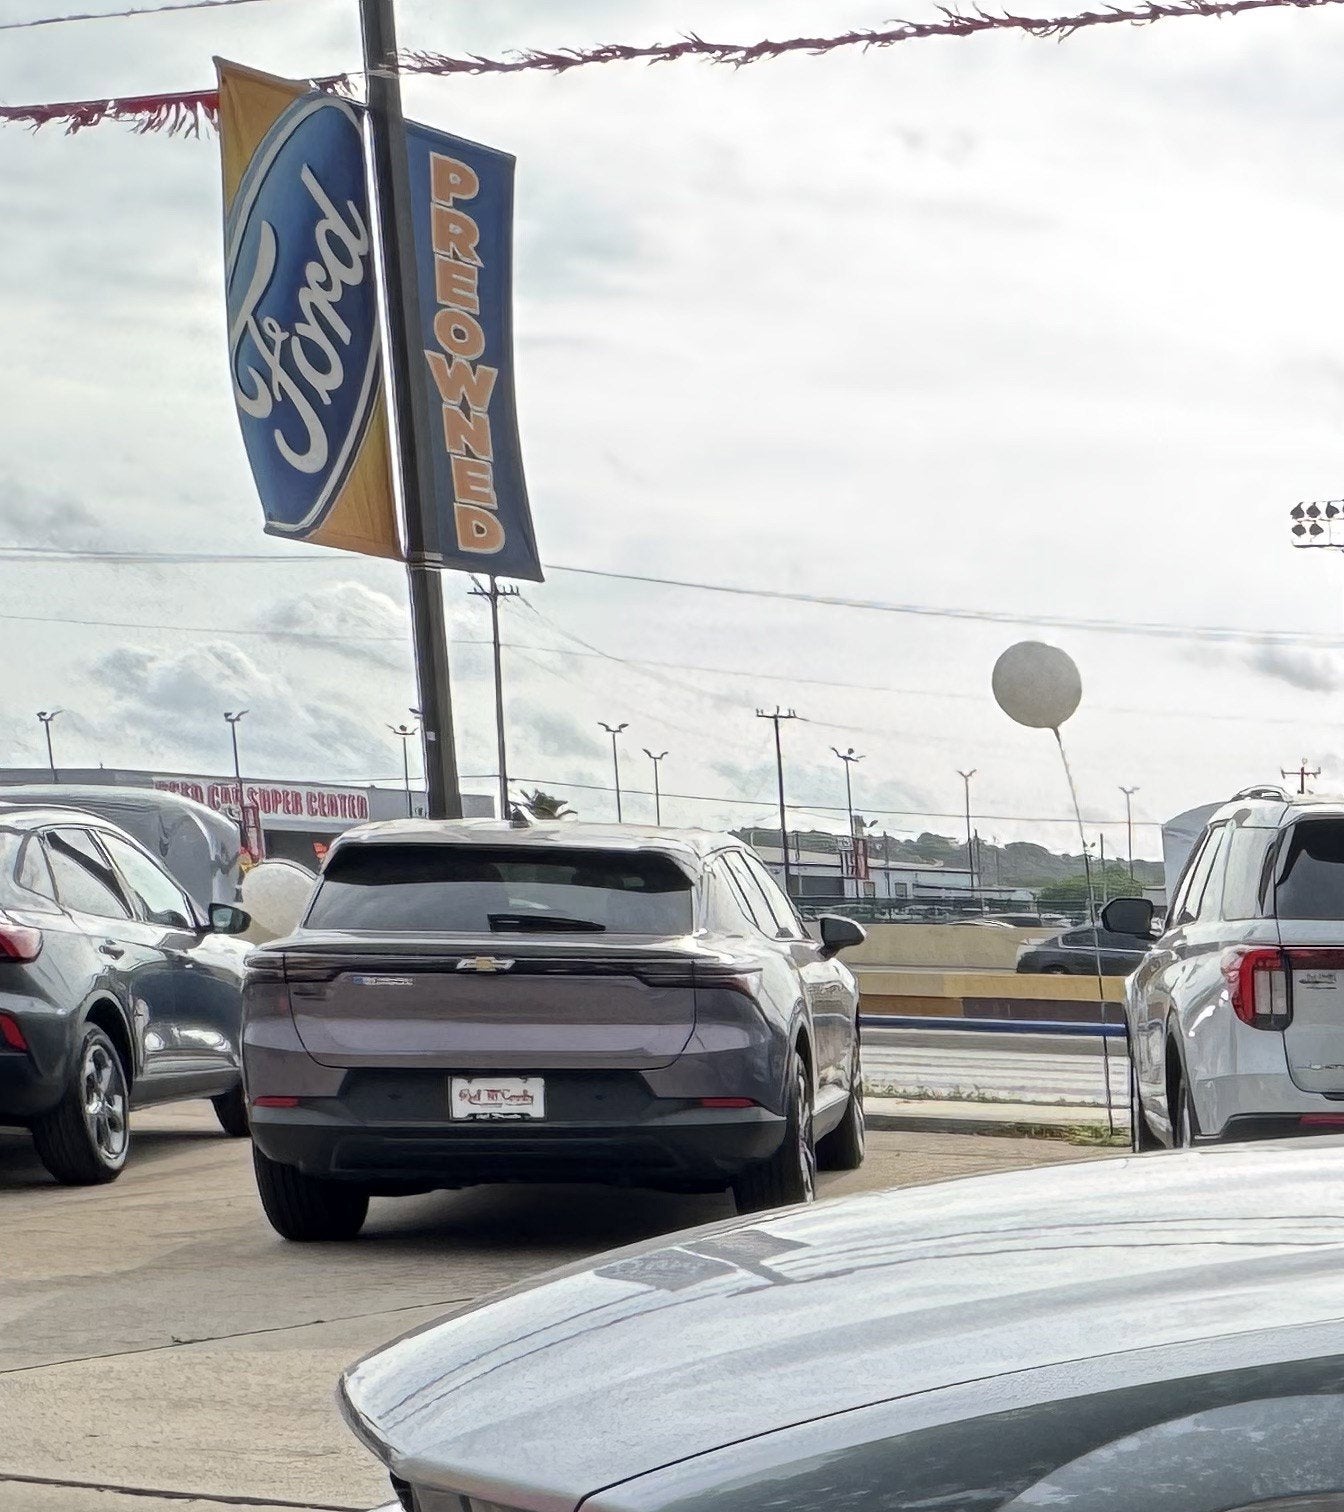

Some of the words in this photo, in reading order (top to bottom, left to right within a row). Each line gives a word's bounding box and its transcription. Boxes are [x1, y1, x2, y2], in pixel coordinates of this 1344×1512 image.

[230, 163, 371, 475] Ford
[424, 150, 506, 554] PREOWNED
[247, 786, 303, 816] SUPER
